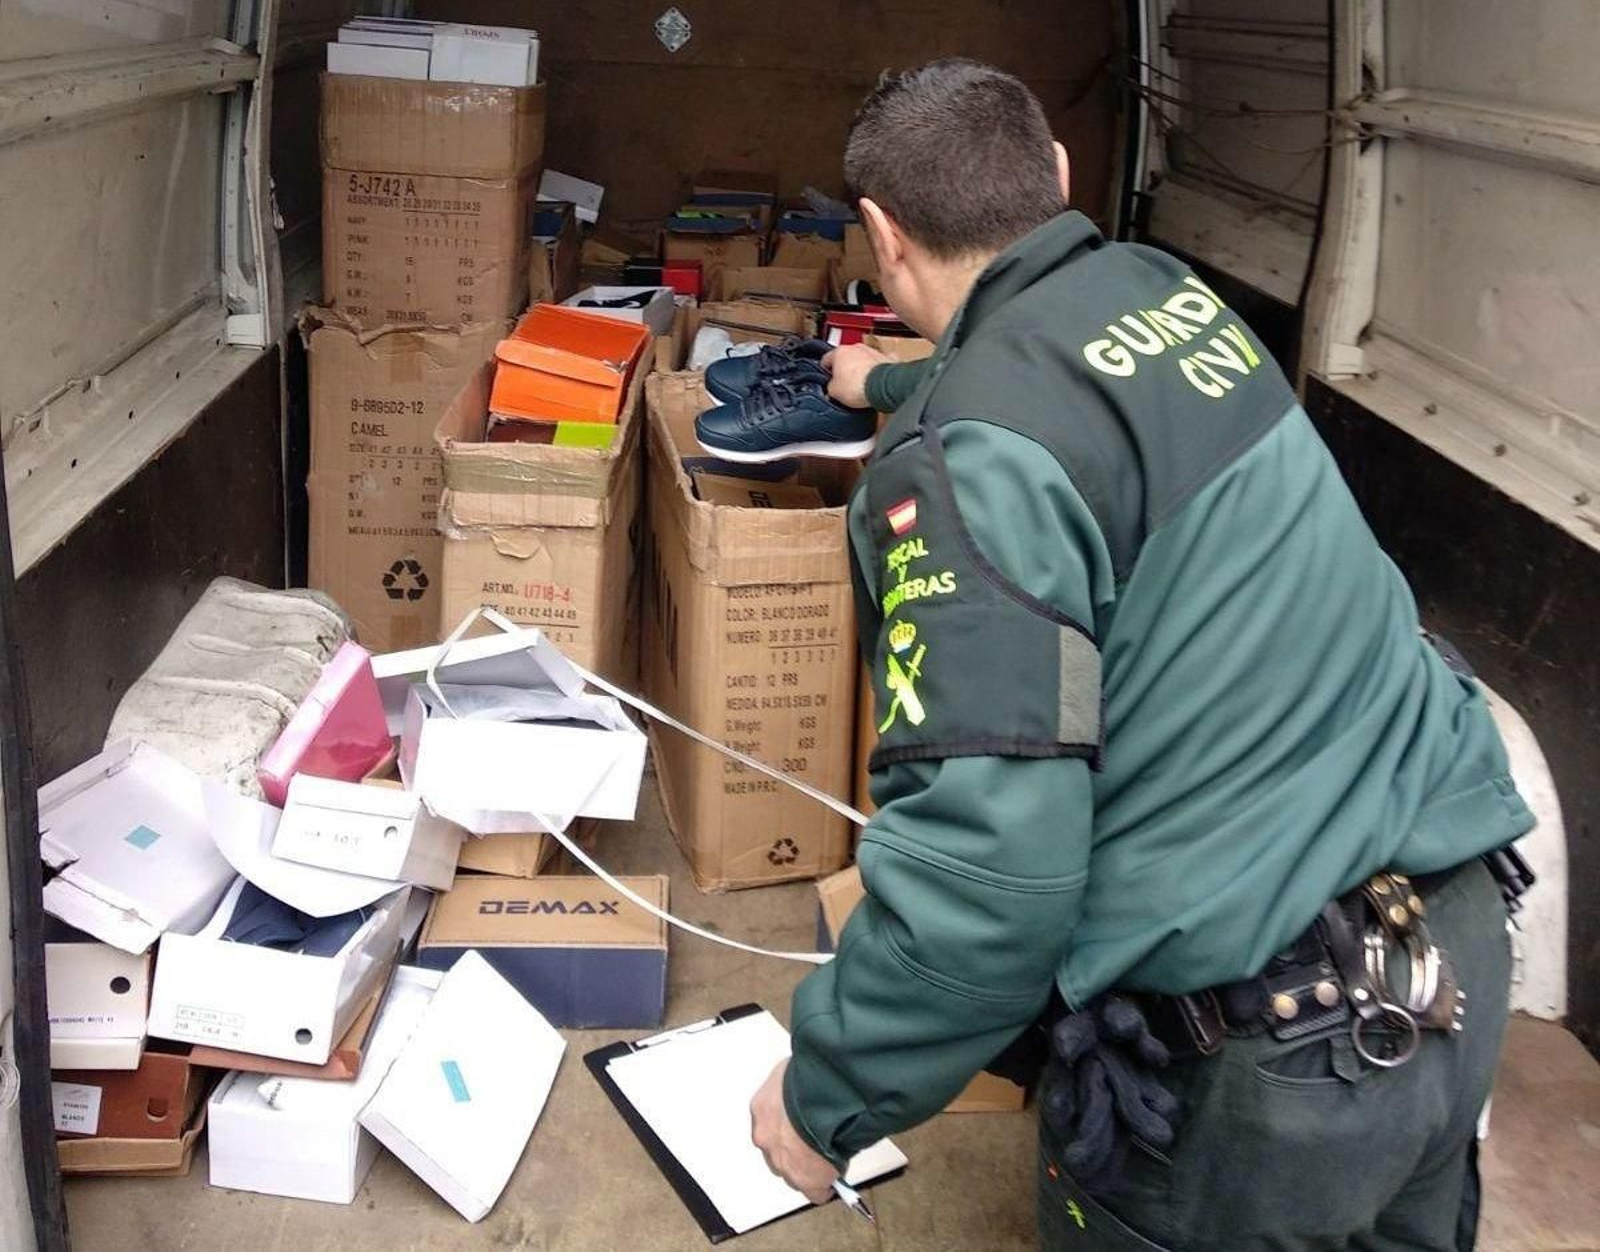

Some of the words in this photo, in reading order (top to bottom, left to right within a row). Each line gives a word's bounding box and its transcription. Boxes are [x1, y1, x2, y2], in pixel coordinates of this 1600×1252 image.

[404, 178, 416, 197] A
[351, 421, 390, 437] CAMEL
[781, 757, 808, 773] 300
[478, 899, 620, 915] DEMAX
